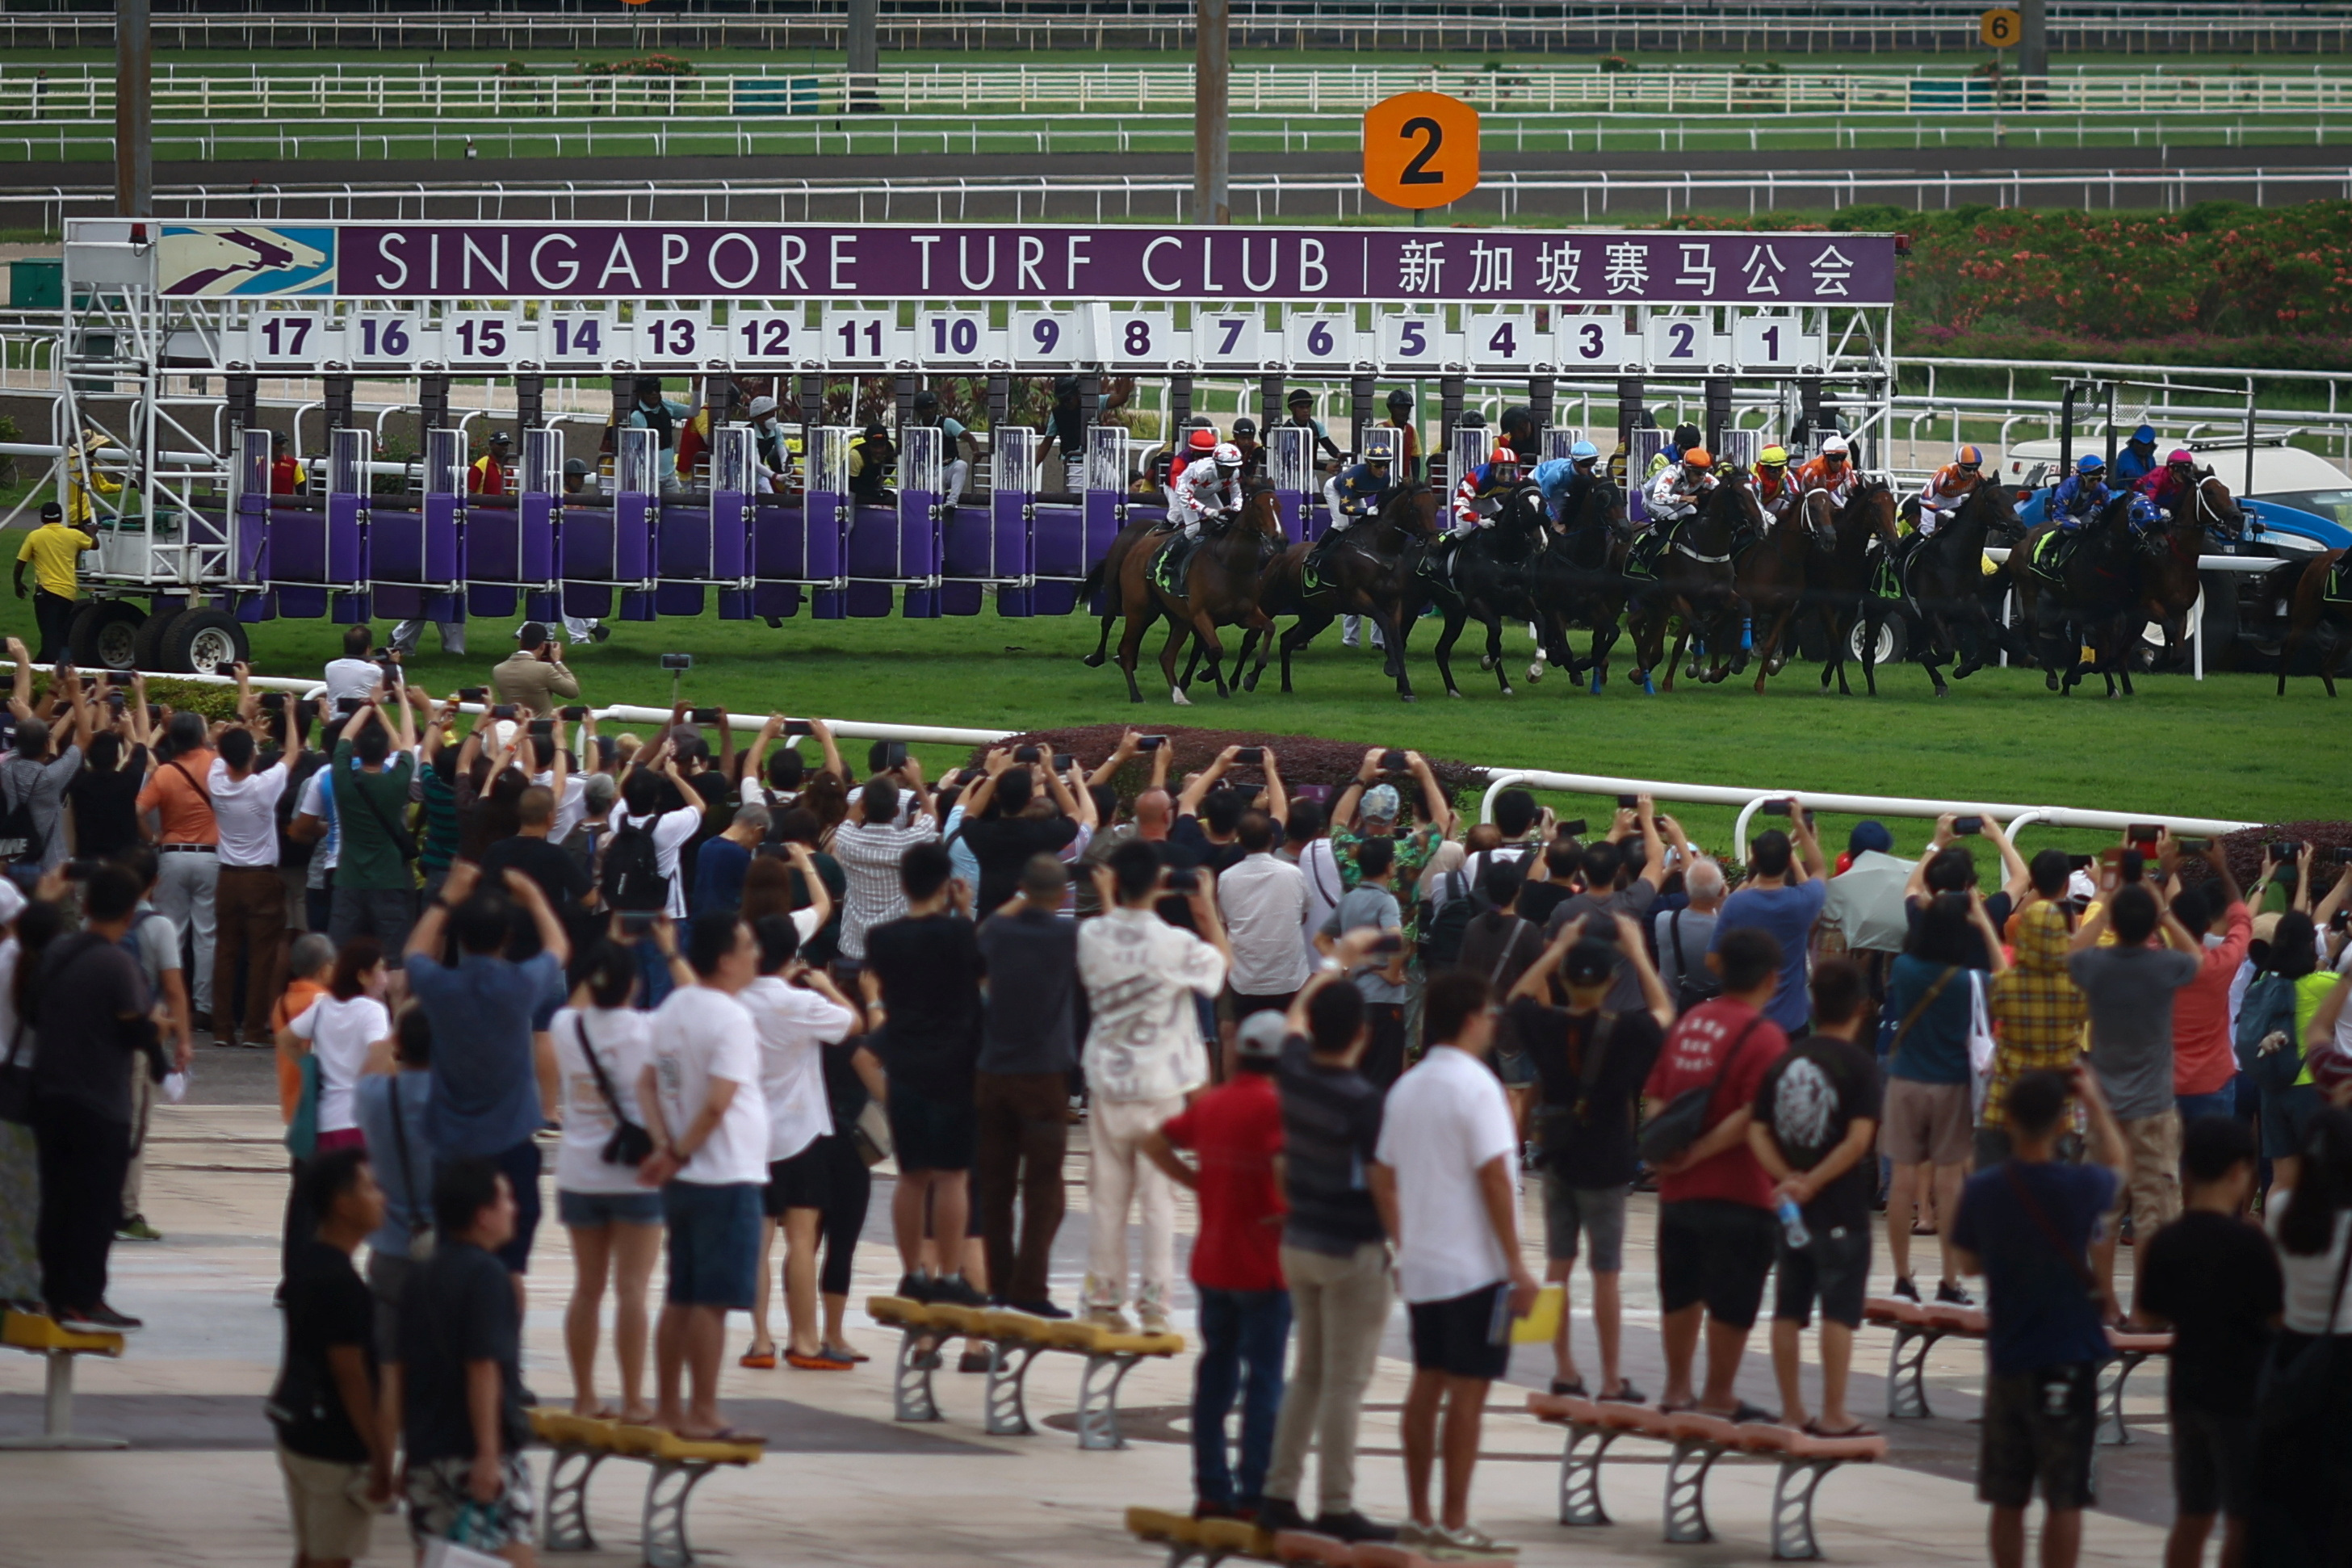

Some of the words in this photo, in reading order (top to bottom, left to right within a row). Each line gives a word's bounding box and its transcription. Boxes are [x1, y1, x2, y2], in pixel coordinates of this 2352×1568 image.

[1992, 16, 2009, 40] 6
[1399, 116, 1444, 185] 2
[375, 232, 857, 291] SINGAPORE
[910, 235, 1092, 291] TURF
[1142, 236, 1328, 292] CLUB
[1398, 238, 1855, 296] 新加坡赛马公会
[261, 317, 312, 355] 17
[359, 318, 409, 357] 16
[455, 319, 506, 358] 15
[551, 319, 602, 356] 14
[647, 318, 695, 356] 13
[740, 319, 790, 356] 12
[837, 320, 882, 357] 11
[931, 318, 978, 355] 10
[1033, 318, 1060, 354] 9
[1124, 320, 1151, 357] 8
[1217, 319, 1246, 354] 7
[1307, 321, 1334, 357] 6
[1398, 321, 1427, 357] 5
[1489, 322, 1516, 358] 4
[1578, 323, 1604, 359] 3
[1668, 322, 1695, 358] 2
[1762, 325, 1779, 361] 1
